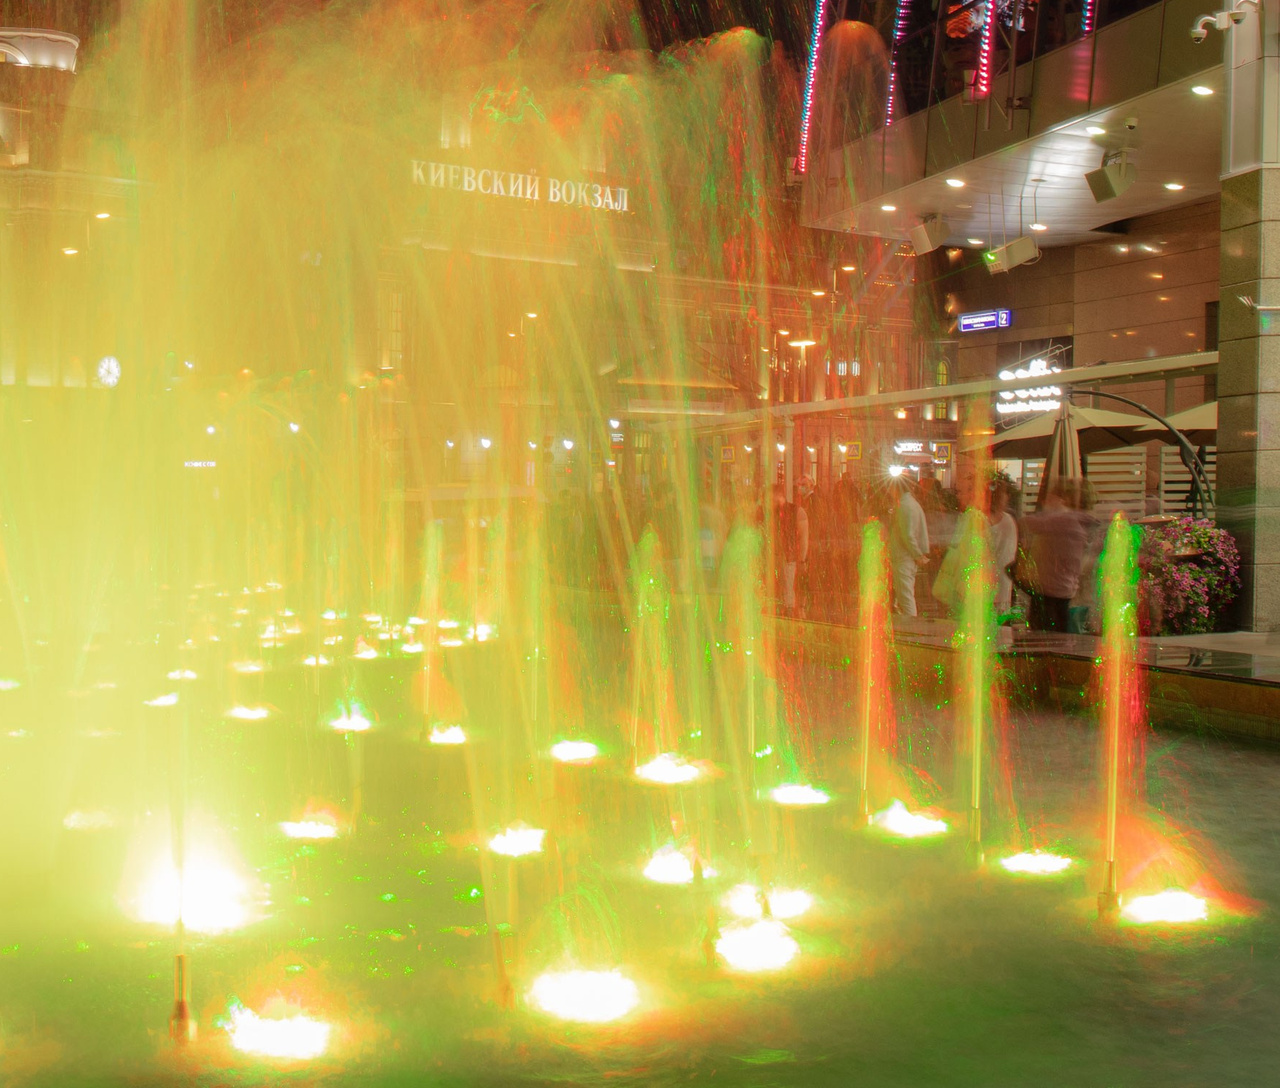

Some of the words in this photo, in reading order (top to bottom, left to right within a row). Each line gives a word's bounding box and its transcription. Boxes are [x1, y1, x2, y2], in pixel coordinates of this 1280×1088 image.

[412, 160, 540, 200] КИЕВСКИЙ
[548, 178, 629, 211] ВОКЗАЛ
[1001, 313, 1007, 324] 2
